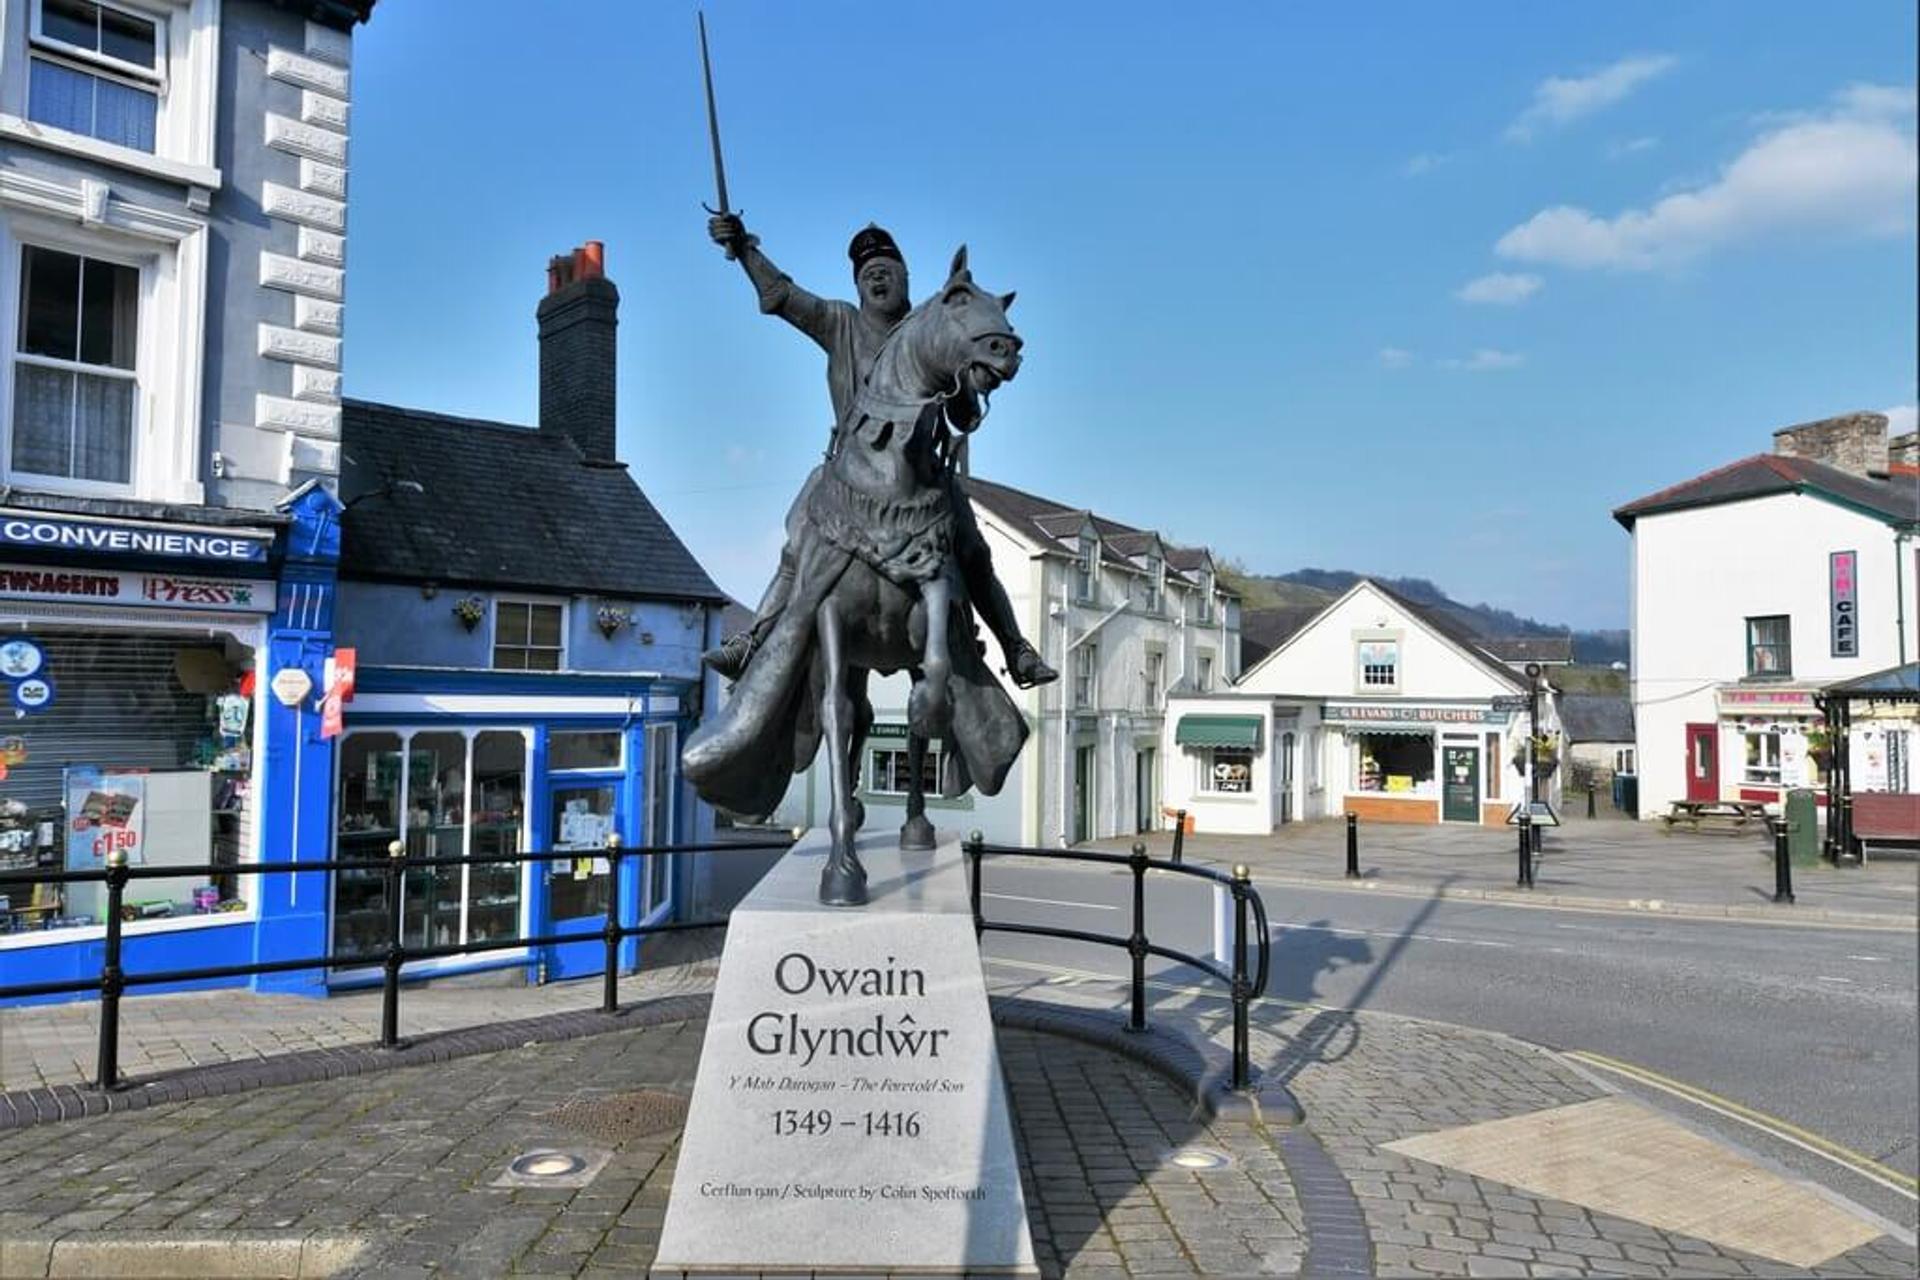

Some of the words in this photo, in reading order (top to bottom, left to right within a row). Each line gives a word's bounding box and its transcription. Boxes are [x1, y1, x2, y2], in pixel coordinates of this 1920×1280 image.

[4, 521, 250, 558] CONVENIENCE
[146, 577, 232, 604] Press
[1836, 600, 1853, 652] CAFE
[1418, 709, 1485, 721] BUTCHERS
[774, 952, 926, 997] Owain
[746, 1011, 949, 1067] Glyndŵr
[728, 1076, 741, 1090] Y
[743, 1076, 776, 1090] Mab
[778, 1077, 836, 1093] Darogan
[852, 1078, 879, 1092] The
[880, 1078, 938, 1092] Foretold
[938, 1079, 965, 1092] Son
[772, 1109, 832, 1137] 1349
[864, 1109, 921, 1138] 1416
[793, 1183, 854, 1201] Sculpture
[859, 1184, 879, 1201] by
[880, 1184, 917, 1199] Colin
